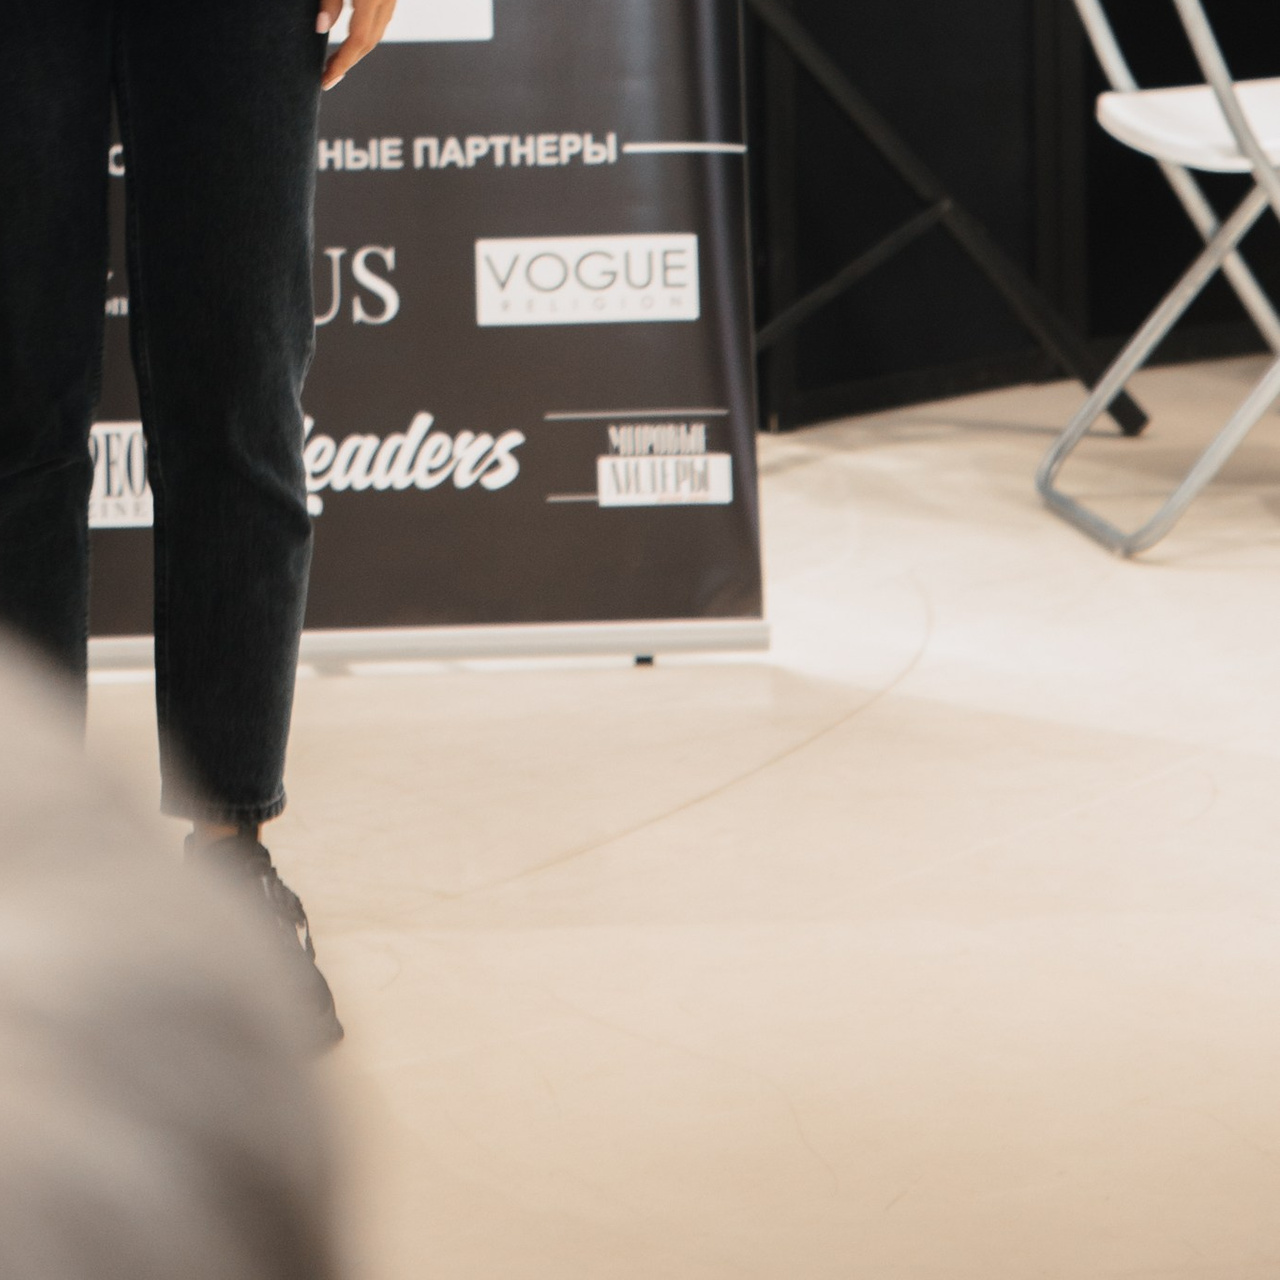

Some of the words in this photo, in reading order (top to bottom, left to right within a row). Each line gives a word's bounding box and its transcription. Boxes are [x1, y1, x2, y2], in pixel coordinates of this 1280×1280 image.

[413, 133, 617, 168] ПАРТНЕРЫ
[485, 250, 687, 293] VOGUE
[501, 294, 684, 313] RELIGION
[303, 410, 526, 492] eaders
